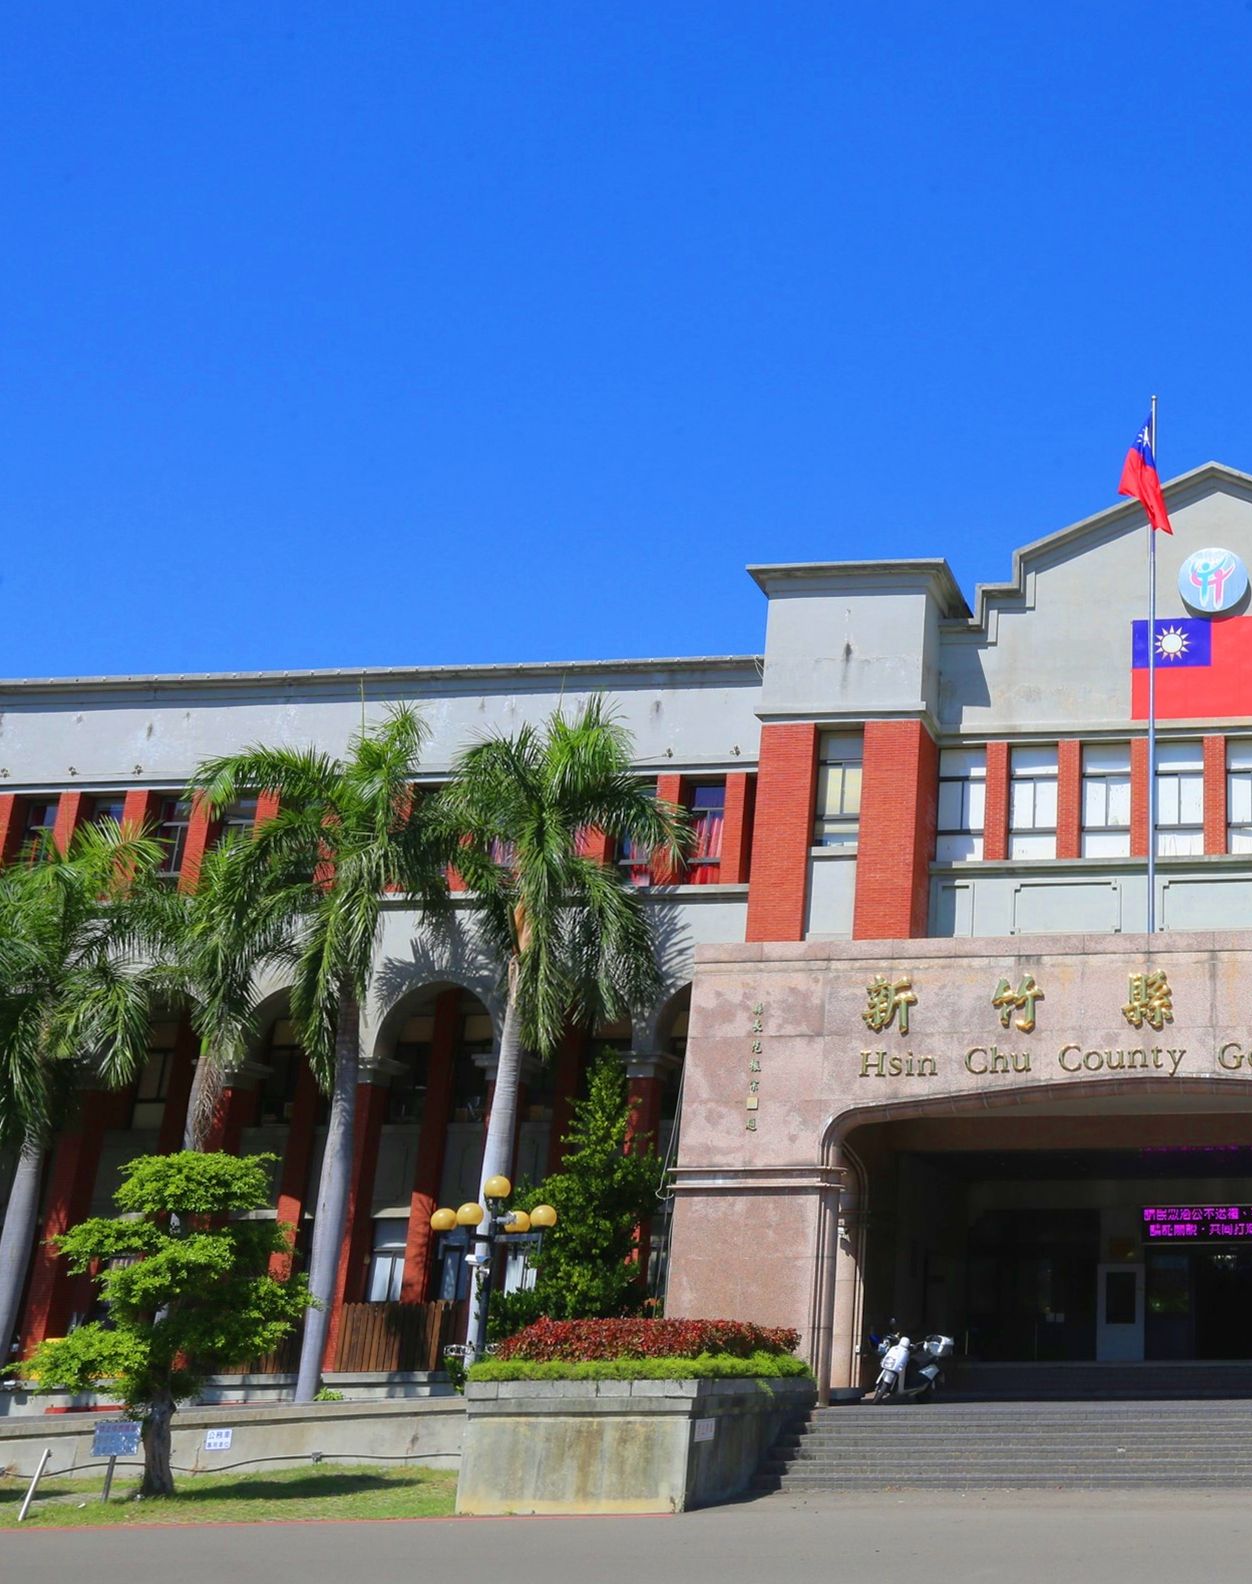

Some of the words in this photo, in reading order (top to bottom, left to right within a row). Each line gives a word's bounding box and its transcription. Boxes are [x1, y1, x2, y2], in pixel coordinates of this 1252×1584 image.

[858, 1049, 939, 1078] Hsin
[964, 1044, 1032, 1075] Chu
[1058, 1043, 1187, 1077] County
